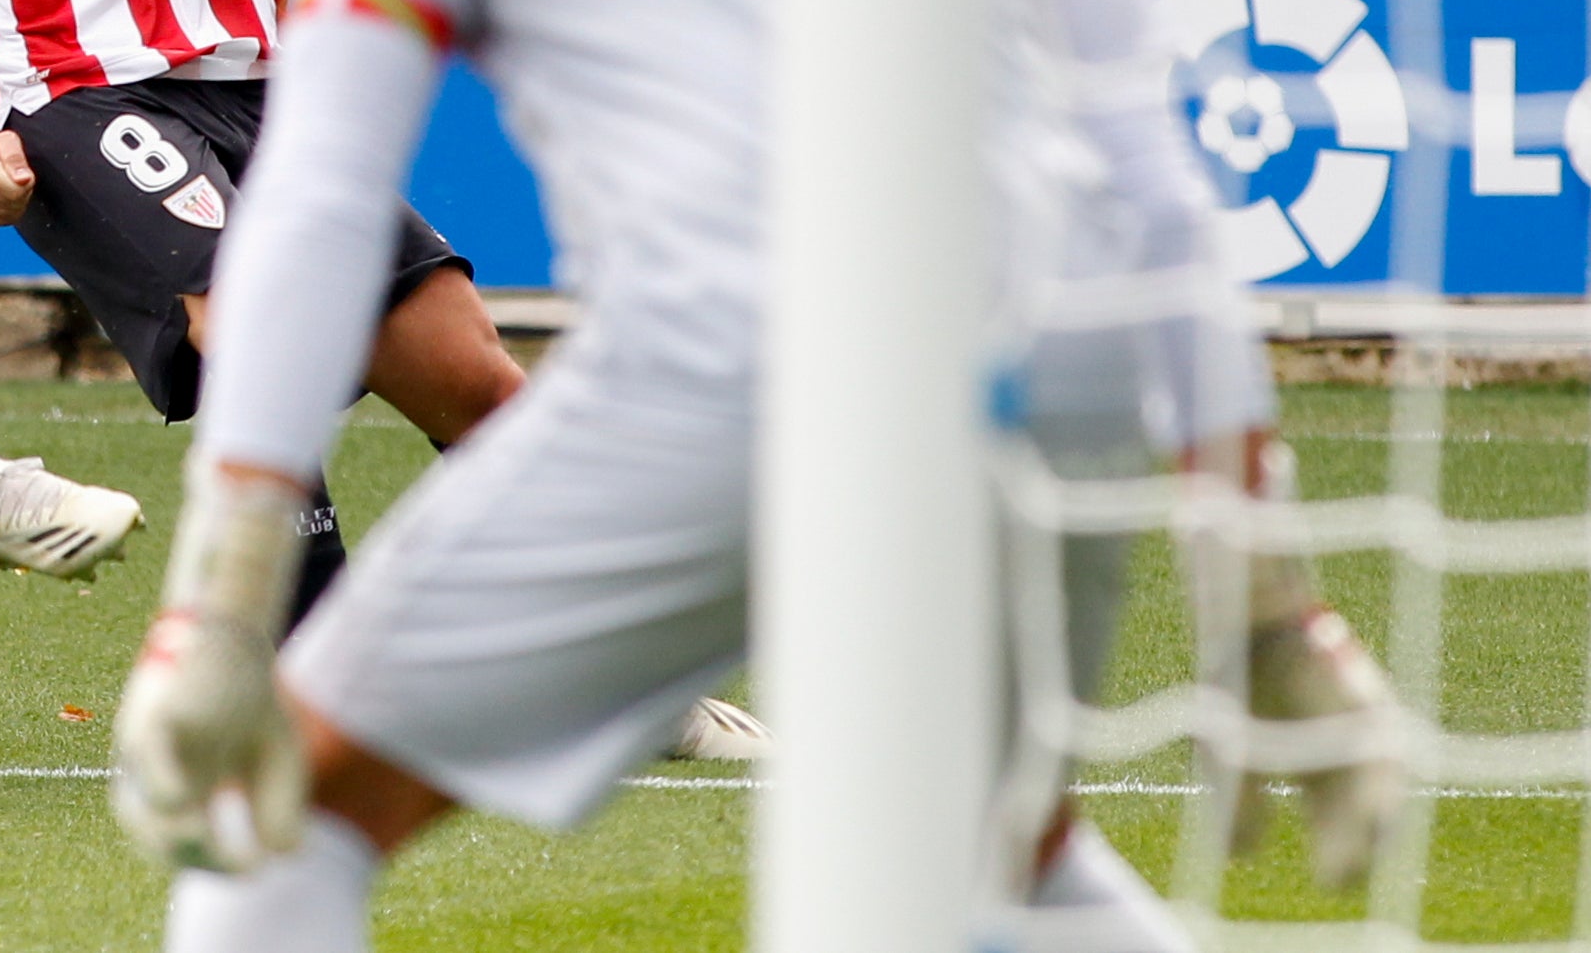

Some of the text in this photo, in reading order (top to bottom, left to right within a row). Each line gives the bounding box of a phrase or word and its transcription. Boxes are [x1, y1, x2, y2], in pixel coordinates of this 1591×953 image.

[1470, 36, 1591, 197] L
[99, 113, 189, 193] 8
[295, 519, 334, 536] LUB
[299, 506, 336, 523] LET
